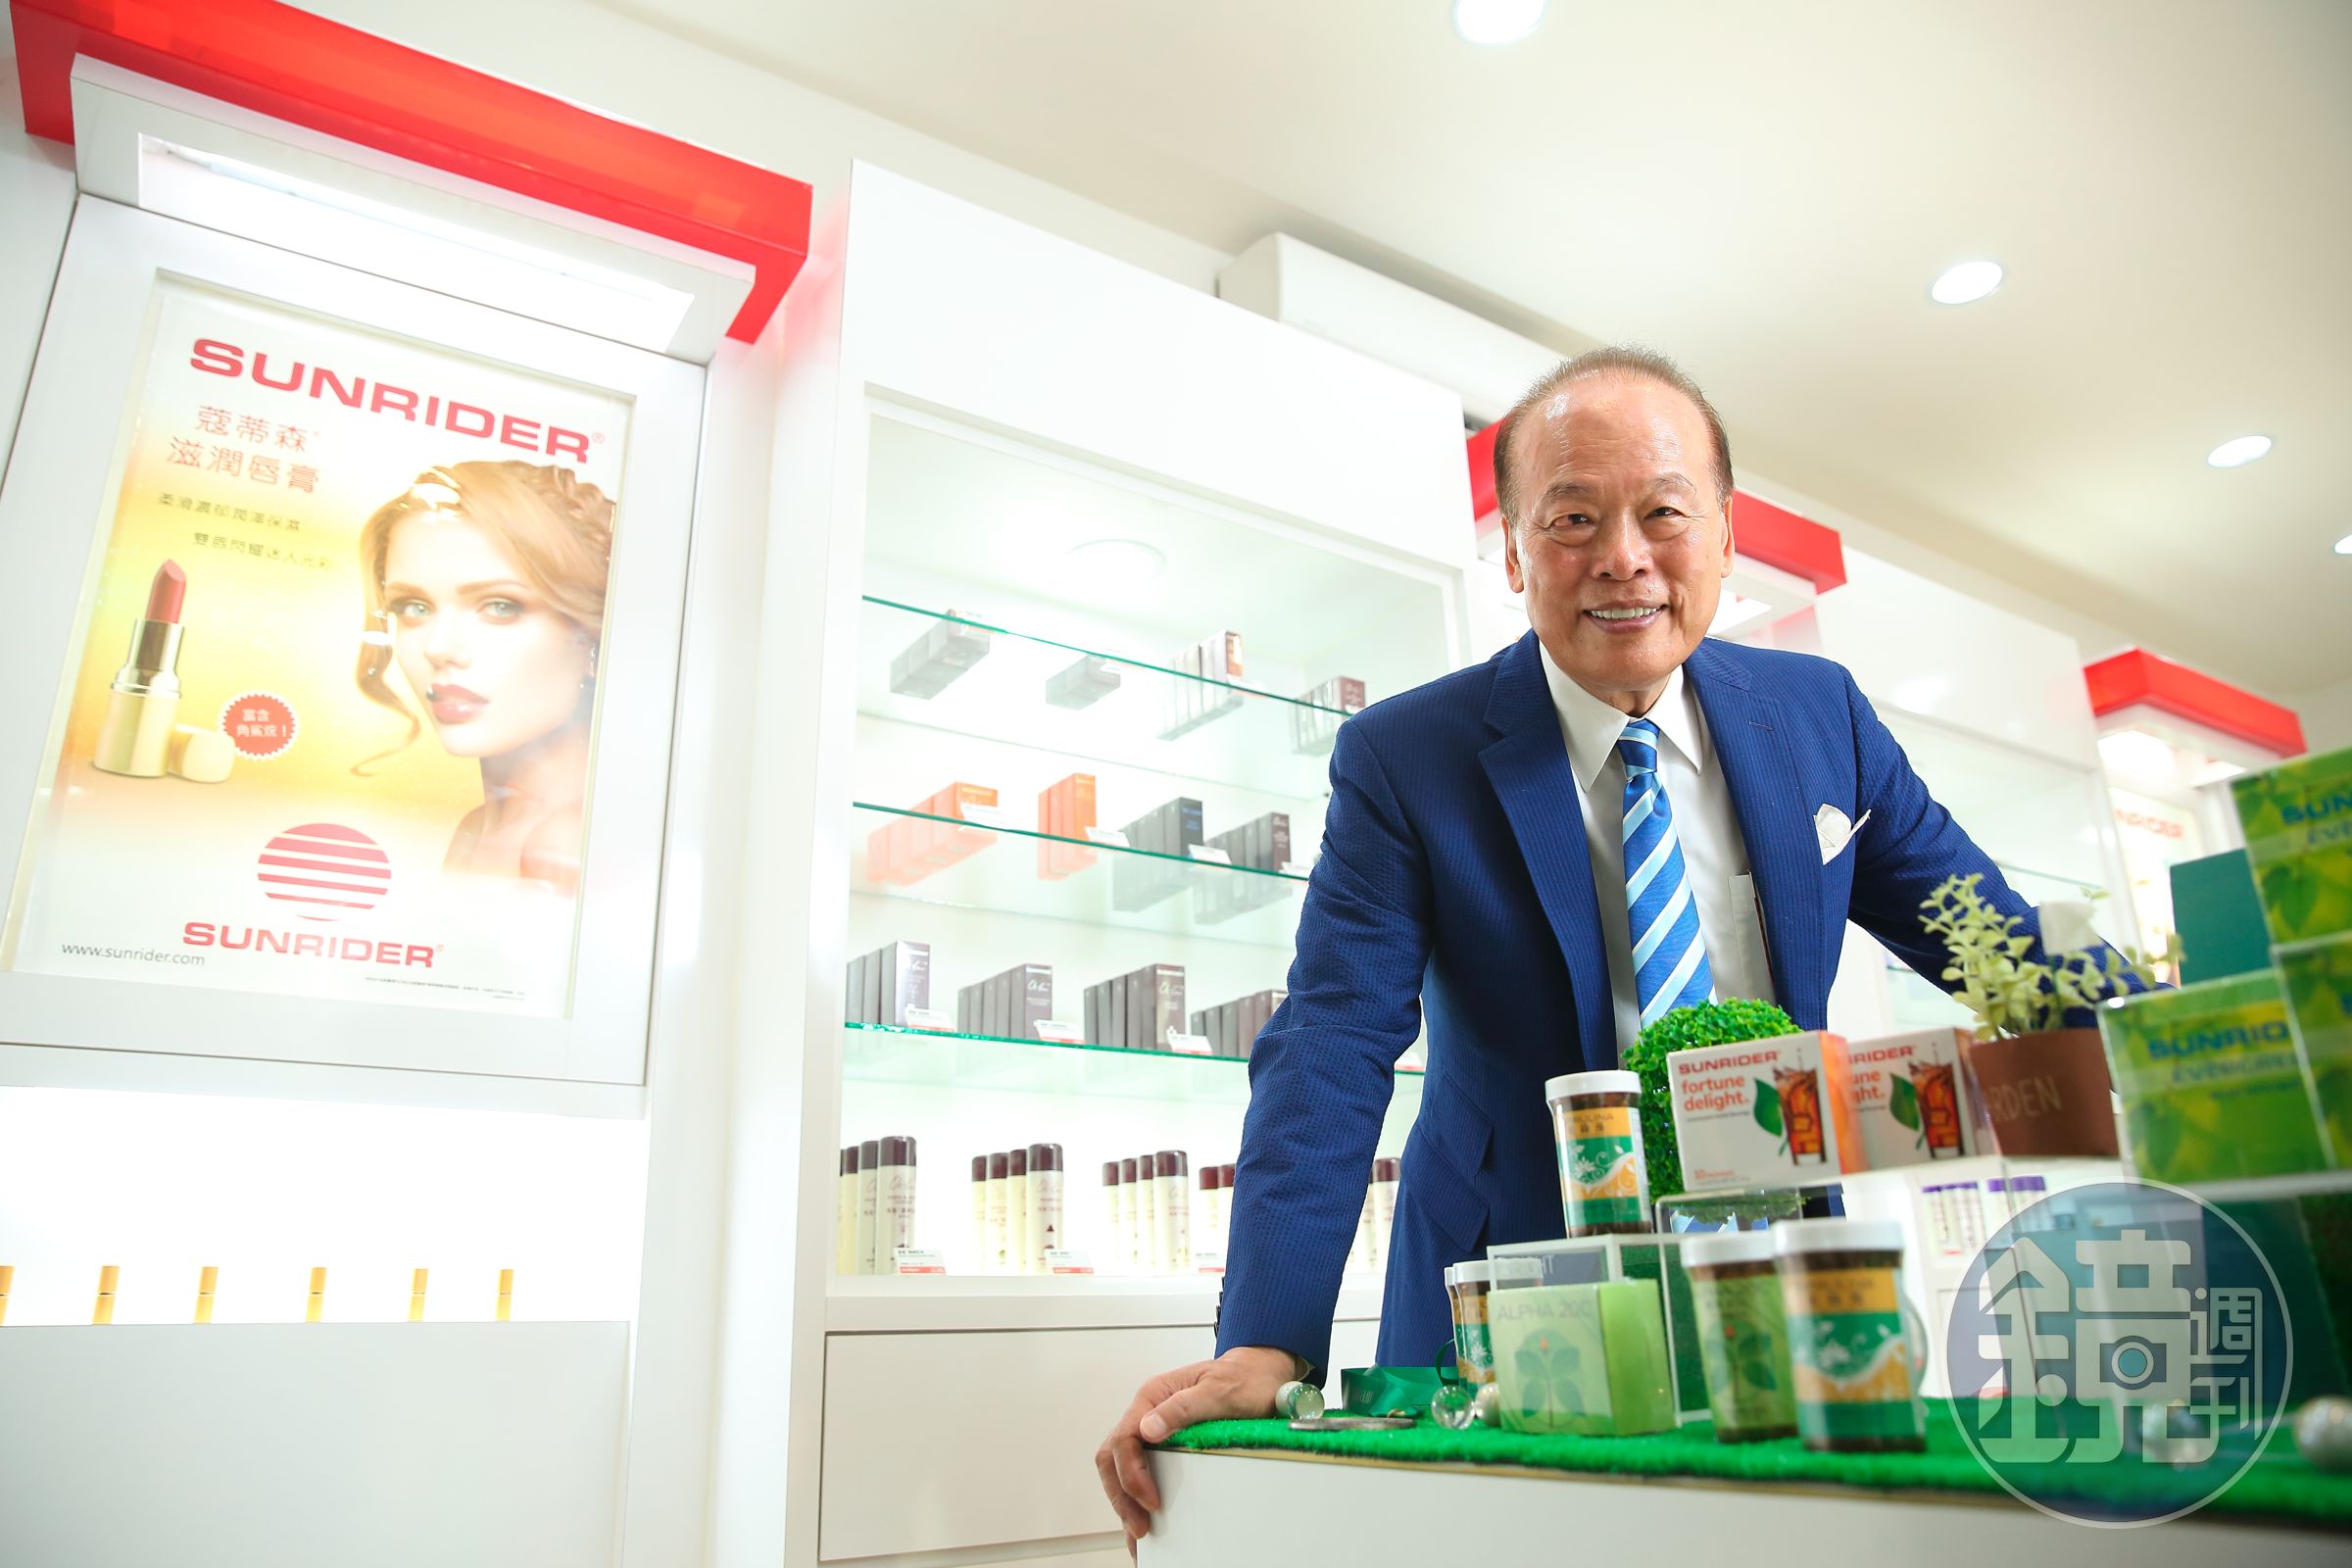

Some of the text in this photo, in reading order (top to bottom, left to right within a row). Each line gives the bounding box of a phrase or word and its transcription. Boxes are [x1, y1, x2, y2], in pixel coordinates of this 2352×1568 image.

[189, 338, 590, 464] SUNRIDER
[195, 405, 309, 453] 蔻蒂森
[166, 435, 319, 494] 滋潤唇膏
[62, 941, 206, 966] www.sunrider.com
[182, 921, 435, 968] SUNRIDER
[1678, 1051, 1780, 1076] SUNRIDER
[1848, 1046, 1914, 1064] RIDER
[1682, 1073, 1745, 1095] fortune
